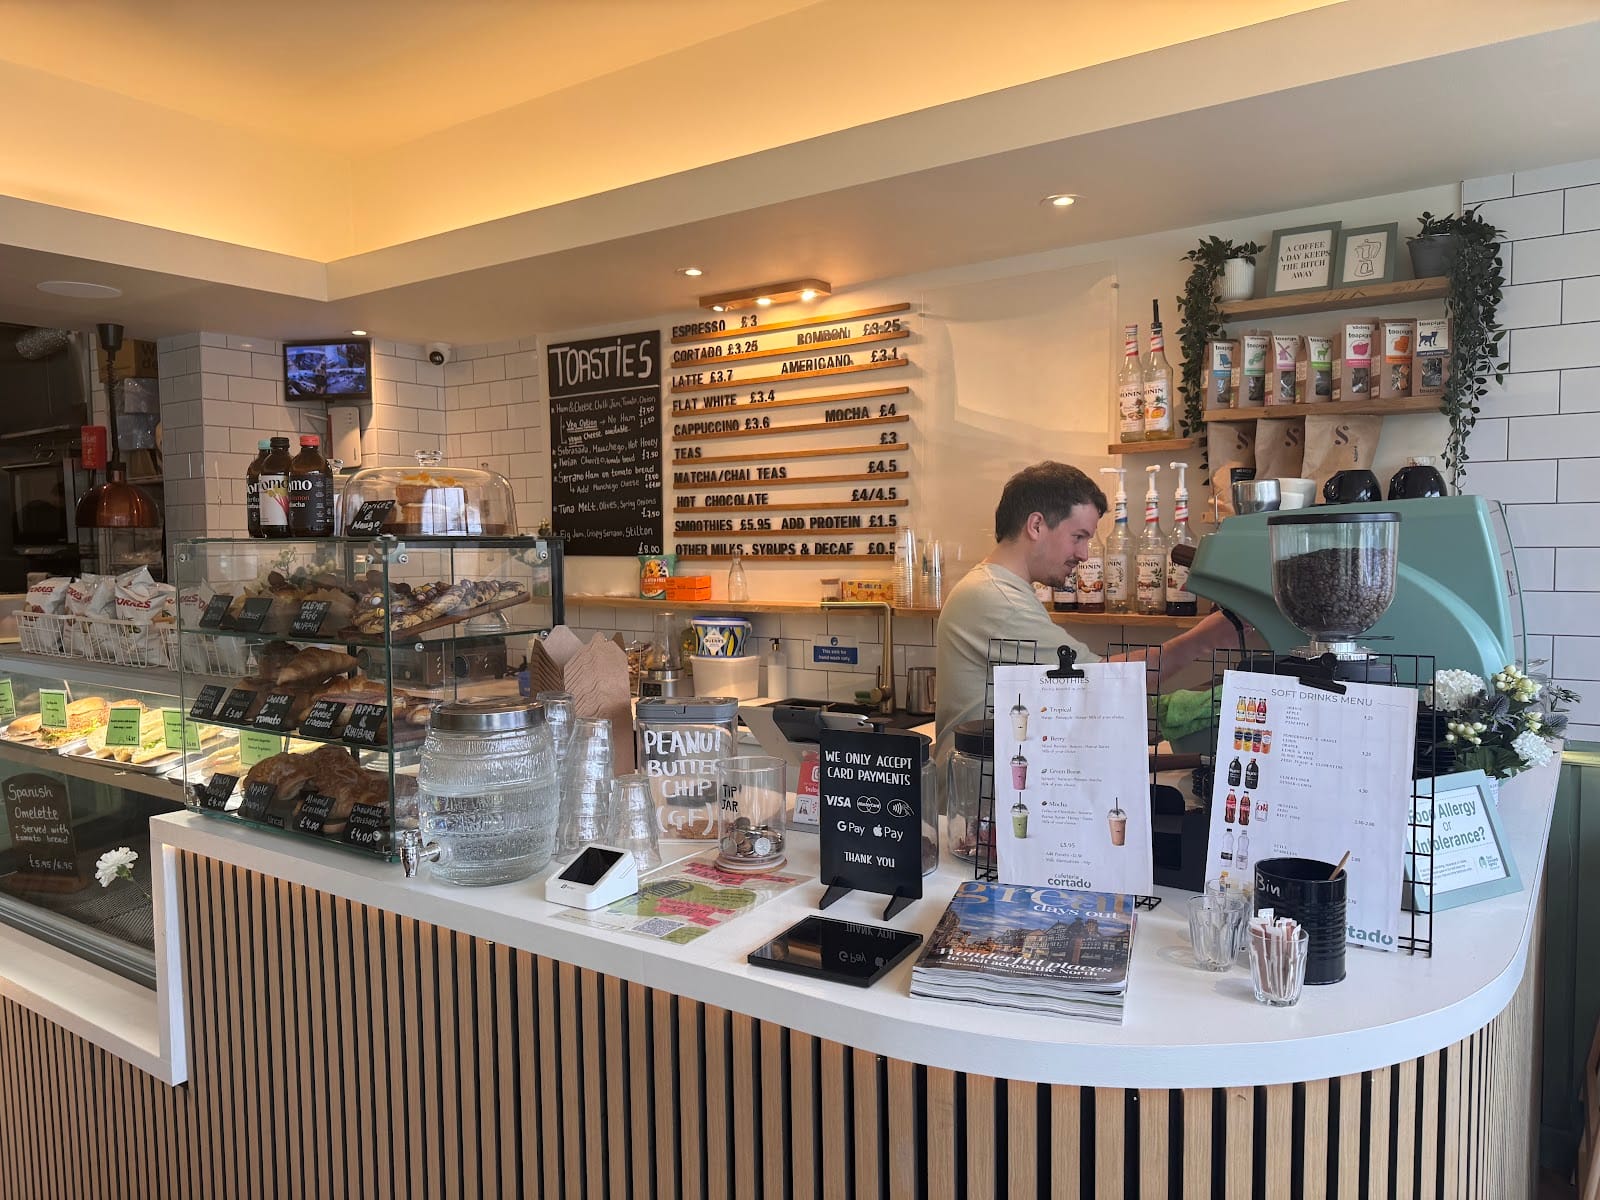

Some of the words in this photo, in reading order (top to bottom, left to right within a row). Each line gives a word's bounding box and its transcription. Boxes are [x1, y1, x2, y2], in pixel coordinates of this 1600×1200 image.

[1294, 240, 1326, 252] COFFEE
[1286, 254, 1302, 262] DAY
[1304, 250, 1331, 259] KEEPS
[1282, 262, 1298, 272] THE
[1300, 259, 1326, 268] BITCH
[1291, 270, 1314, 280] AWAY
[672, 319, 726, 338] ESPRESSO
[862, 318, 901, 337] £3.25
[673, 345, 722, 363] CORTADO
[726, 340, 758, 356] £3.25
[870, 348, 899, 364] £3.1
[672, 372, 704, 388] LATTE
[710, 369, 734, 384] £3.7
[672, 396, 698, 412] FLAT
[704, 394, 738, 409] WHITE
[750, 390, 776, 404] £3.4
[608, 415, 616, 424] No
[620, 413, 636, 422] Ham
[825, 406, 870, 423] MOCHA
[879, 402, 897, 418] £4
[673, 418, 740, 437] CAPPUCCINO
[744, 416, 770, 430] £3.6
[880, 432, 898, 445] £3
[674, 446, 702, 460] TEAS
[584, 470, 600, 480] Ham
[611, 468, 633, 478] tomato
[866, 459, 898, 474] £4.5
[674, 468, 750, 485] MATCHA/CHAI
[756, 466, 787, 480] TEAS
[676, 495, 696, 508] HOT
[704, 493, 769, 508] CHOCOLATE
[850, 487, 897, 502] £4/4.5
[558, 504, 575, 514] Tuna
[674, 519, 734, 532] SMOOTHIES
[739, 518, 772, 531] £5.95
[780, 516, 806, 530] ADD
[809, 515, 862, 530] PROTEIN
[868, 514, 898, 528] £1.5
[626, 525, 654, 538] Stilton
[638, 542, 660, 554] £8.00
[674, 543, 708, 556] OTHER
[752, 542, 796, 556] SYRUPS
[800, 542, 810, 556] &
[814, 542, 854, 556] DECAF
[1040, 676, 1090, 685] SMOOTHIES
[1271, 688, 1298, 699] SOFT
[1300, 692, 1338, 704] DRINKS
[1340, 696, 1373, 708] MENU
[354, 704, 384, 716] APPLE
[1050, 706, 1072, 714] Tropical
[644, 730, 721, 756] PEANUT
[825, 750, 841, 763] WE
[845, 752, 872, 766] ONLY
[876, 755, 912, 770] ACCEPT
[647, 758, 727, 778] BUTTER
[827, 766, 854, 780] CARD
[858, 769, 911, 786] PAYMENTS
[8, 784, 54, 804] Spanish
[662, 778, 712, 798] CHIP
[721, 800, 739, 812] JAR
[824, 794, 852, 808] VISA
[14, 805, 60, 820] Omelette
[1438, 800, 1476, 819] Allergy
[300, 817, 320, 831] £4.00
[656, 802, 714, 836] (GF)
[1442, 820, 1452, 832] or
[50, 824, 70, 835] with
[350, 828, 372, 842] £4.00
[836, 820, 847, 832] G
[848, 822, 866, 837] Pay
[884, 826, 904, 842] Pay
[844, 851, 872, 865] THANK
[876, 856, 896, 868] YOU
[1048, 878, 1092, 889] cortado
[1256, 872, 1282, 898] Bin
[954, 882, 1125, 912] great
[1034, 904, 1080, 917] days
[1086, 910, 1119, 920] out
[940, 947, 1046, 968] Wonderful
[1048, 962, 1113, 975] places
[962, 957, 989, 965] visit
[991, 960, 1033, 970] across
[1058, 968, 1098, 976] North
